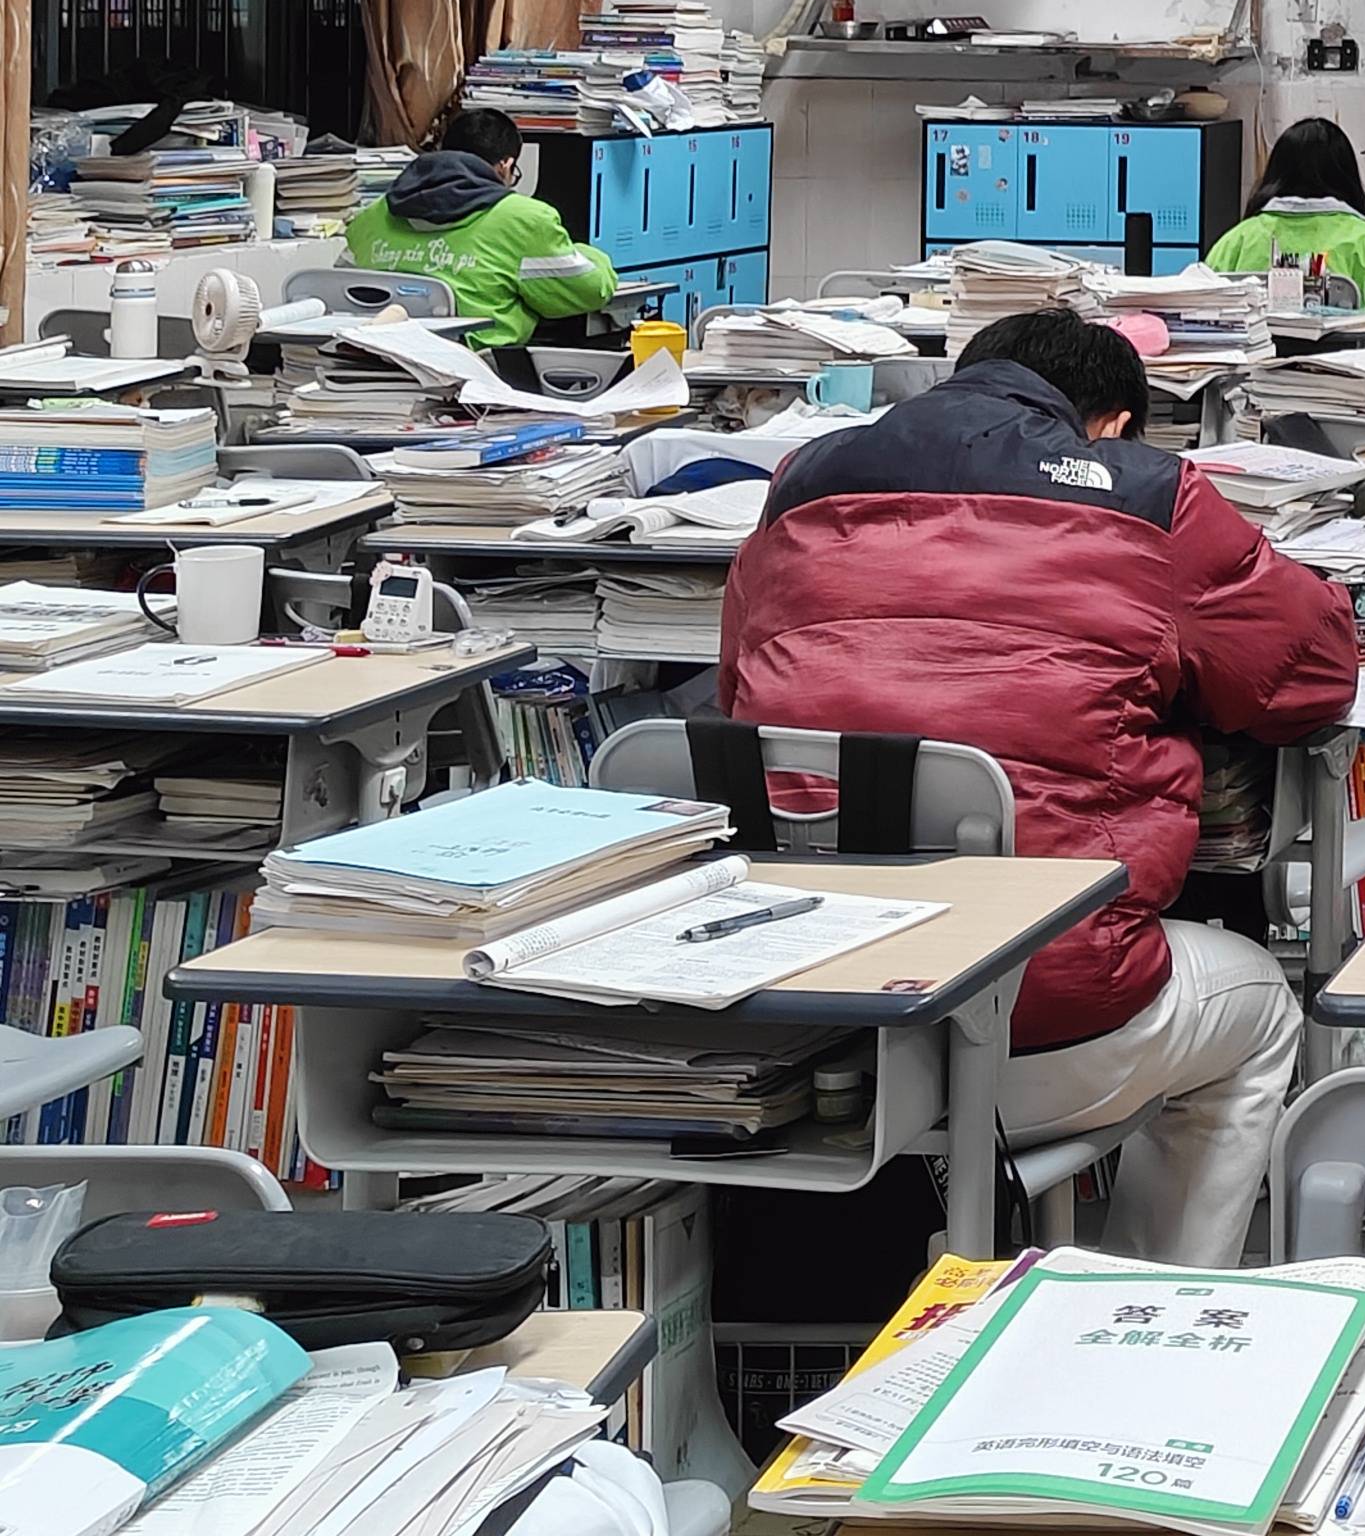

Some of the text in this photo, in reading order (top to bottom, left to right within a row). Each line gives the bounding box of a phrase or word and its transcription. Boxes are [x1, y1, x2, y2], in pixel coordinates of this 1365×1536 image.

[933, 130, 948, 142] 17
[1023, 131, 1039, 143] 18
[1113, 133, 1130, 145] 19
[1039, 461, 1087, 479] NORTH
[1061, 457, 1089, 469] THE
[1051, 473, 1087, 487] FACE
[1112, 1305, 1249, 1329] 答案
[1074, 1329, 1252, 1353] 全解全析
[972, 1437, 1206, 1469] 英语完形填空与语法填空
